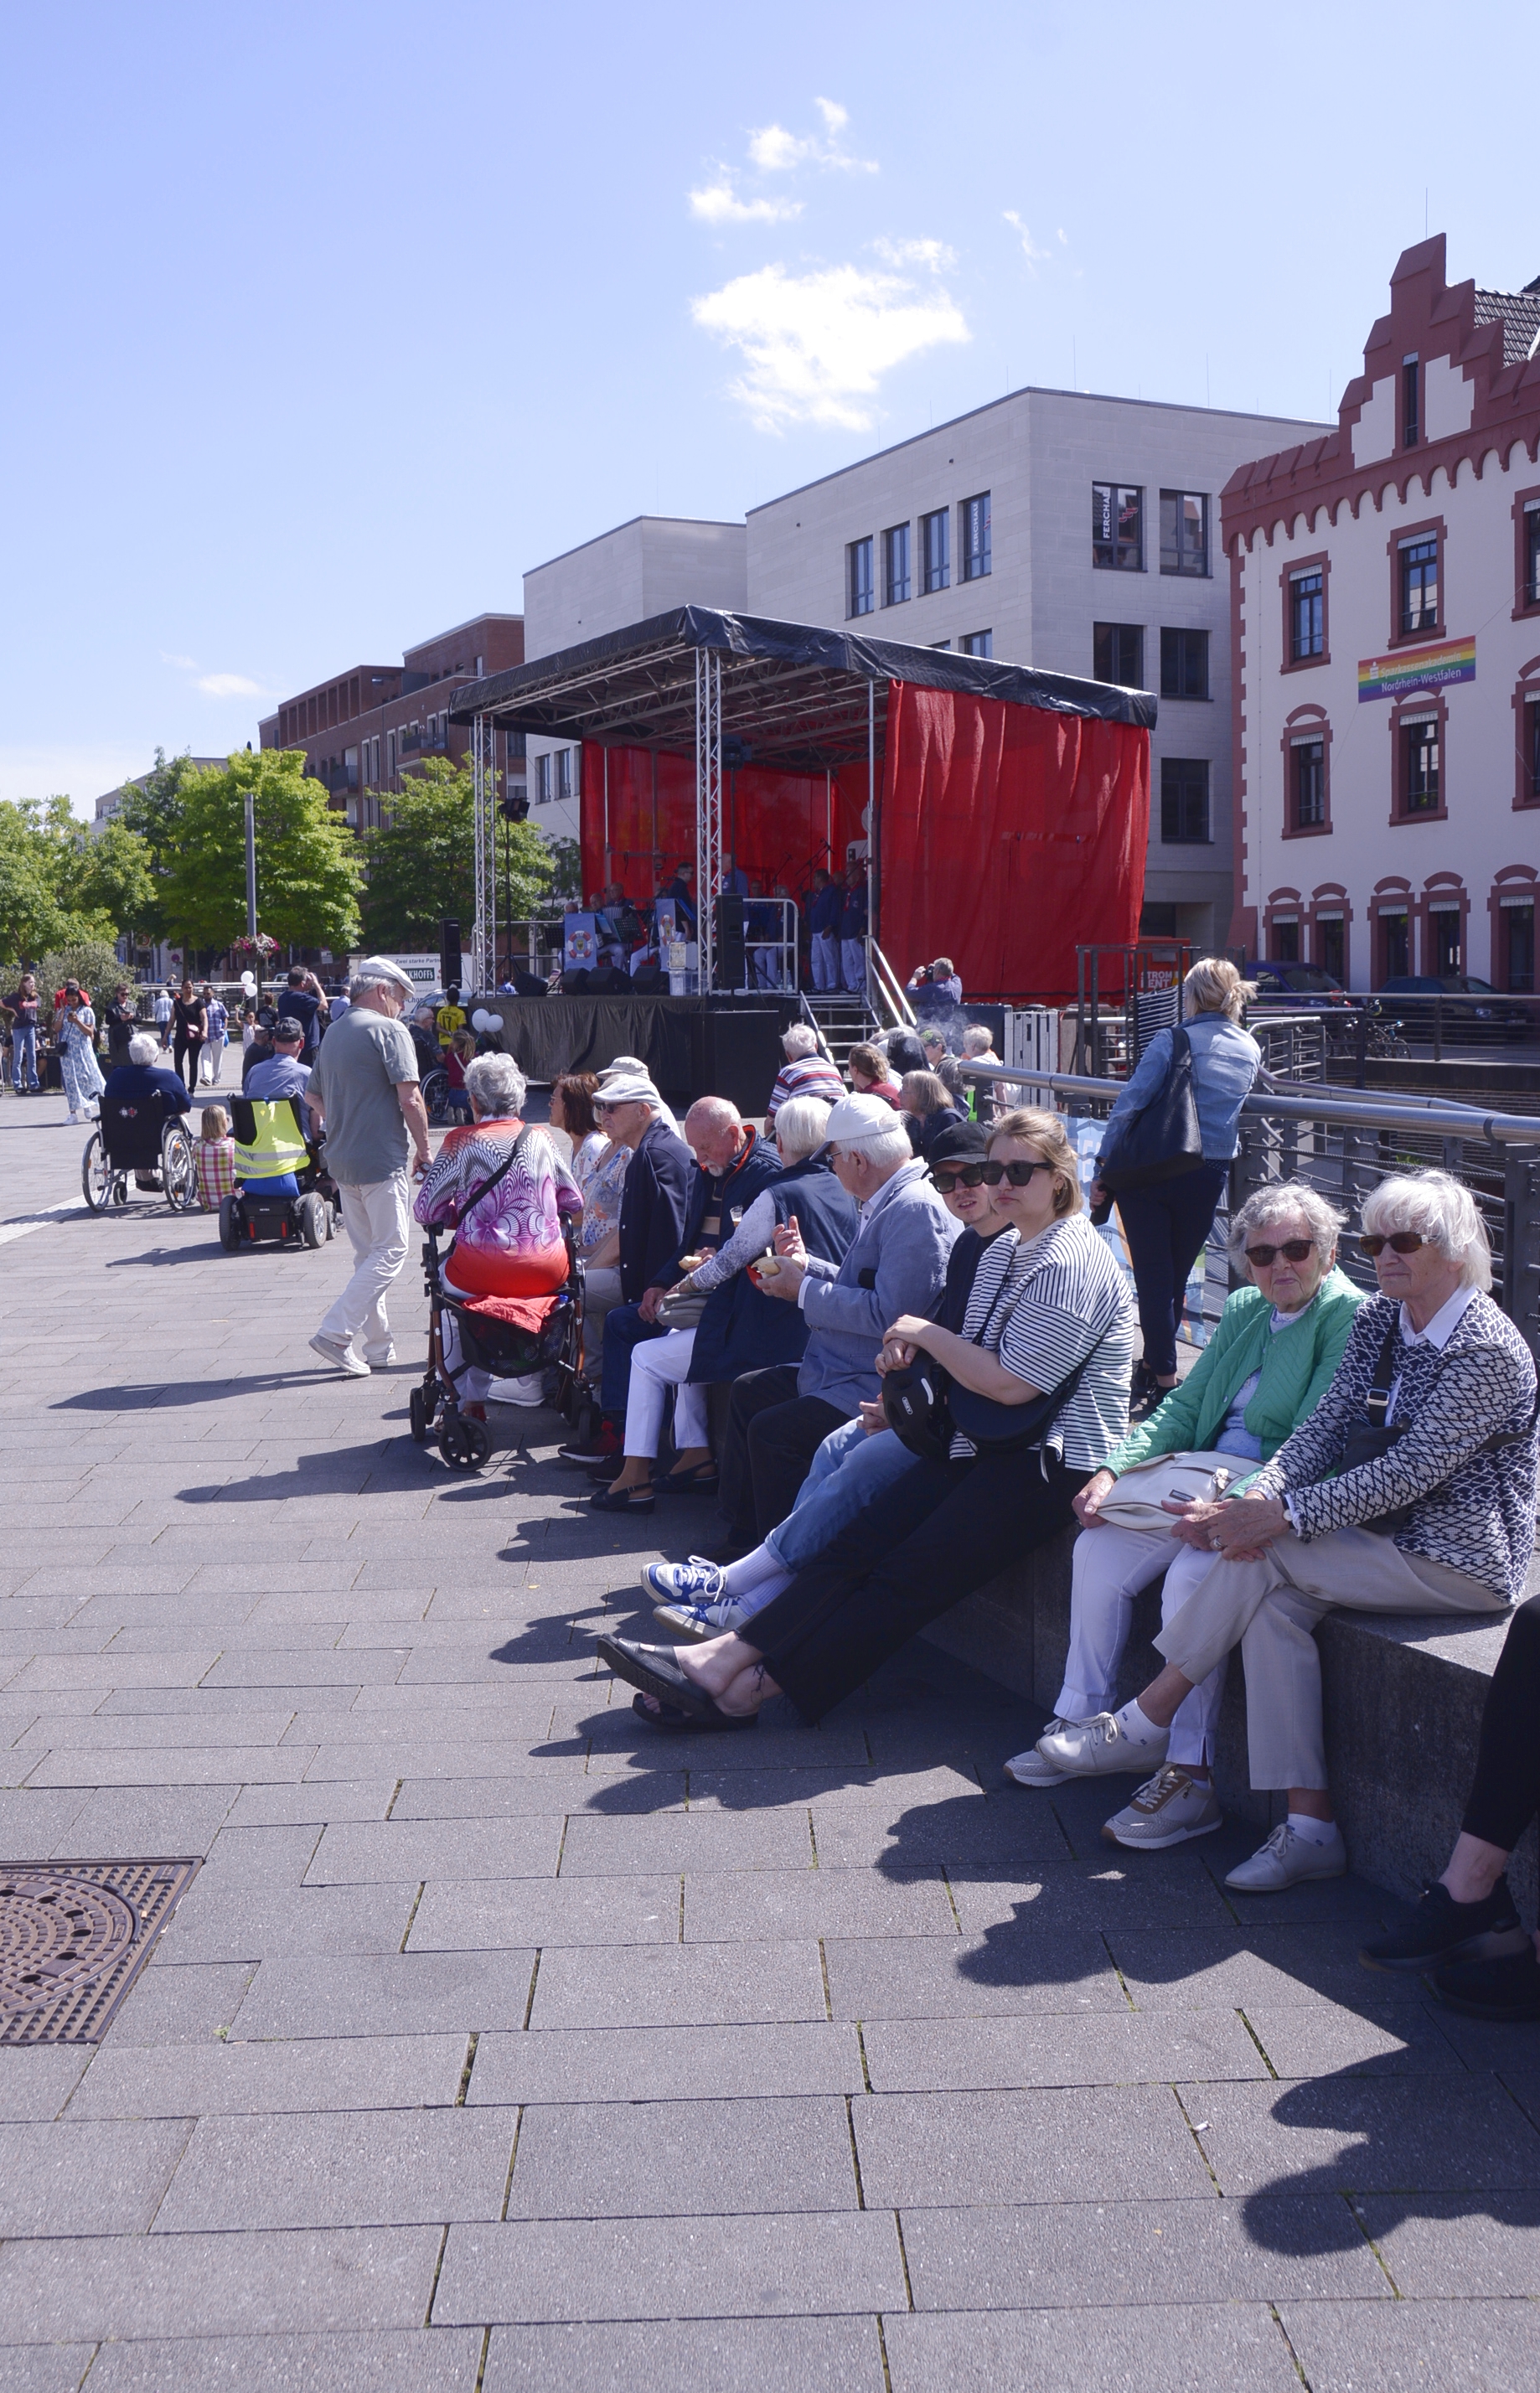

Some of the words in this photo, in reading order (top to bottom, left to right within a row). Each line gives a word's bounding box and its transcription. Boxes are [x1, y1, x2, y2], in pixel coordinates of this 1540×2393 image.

[1381, 652, 1461, 680] Sparkassenakademie
[1382, 668, 1461, 692] Nordrhein-Westfalen
[442, 1015, 452, 1032] 17
